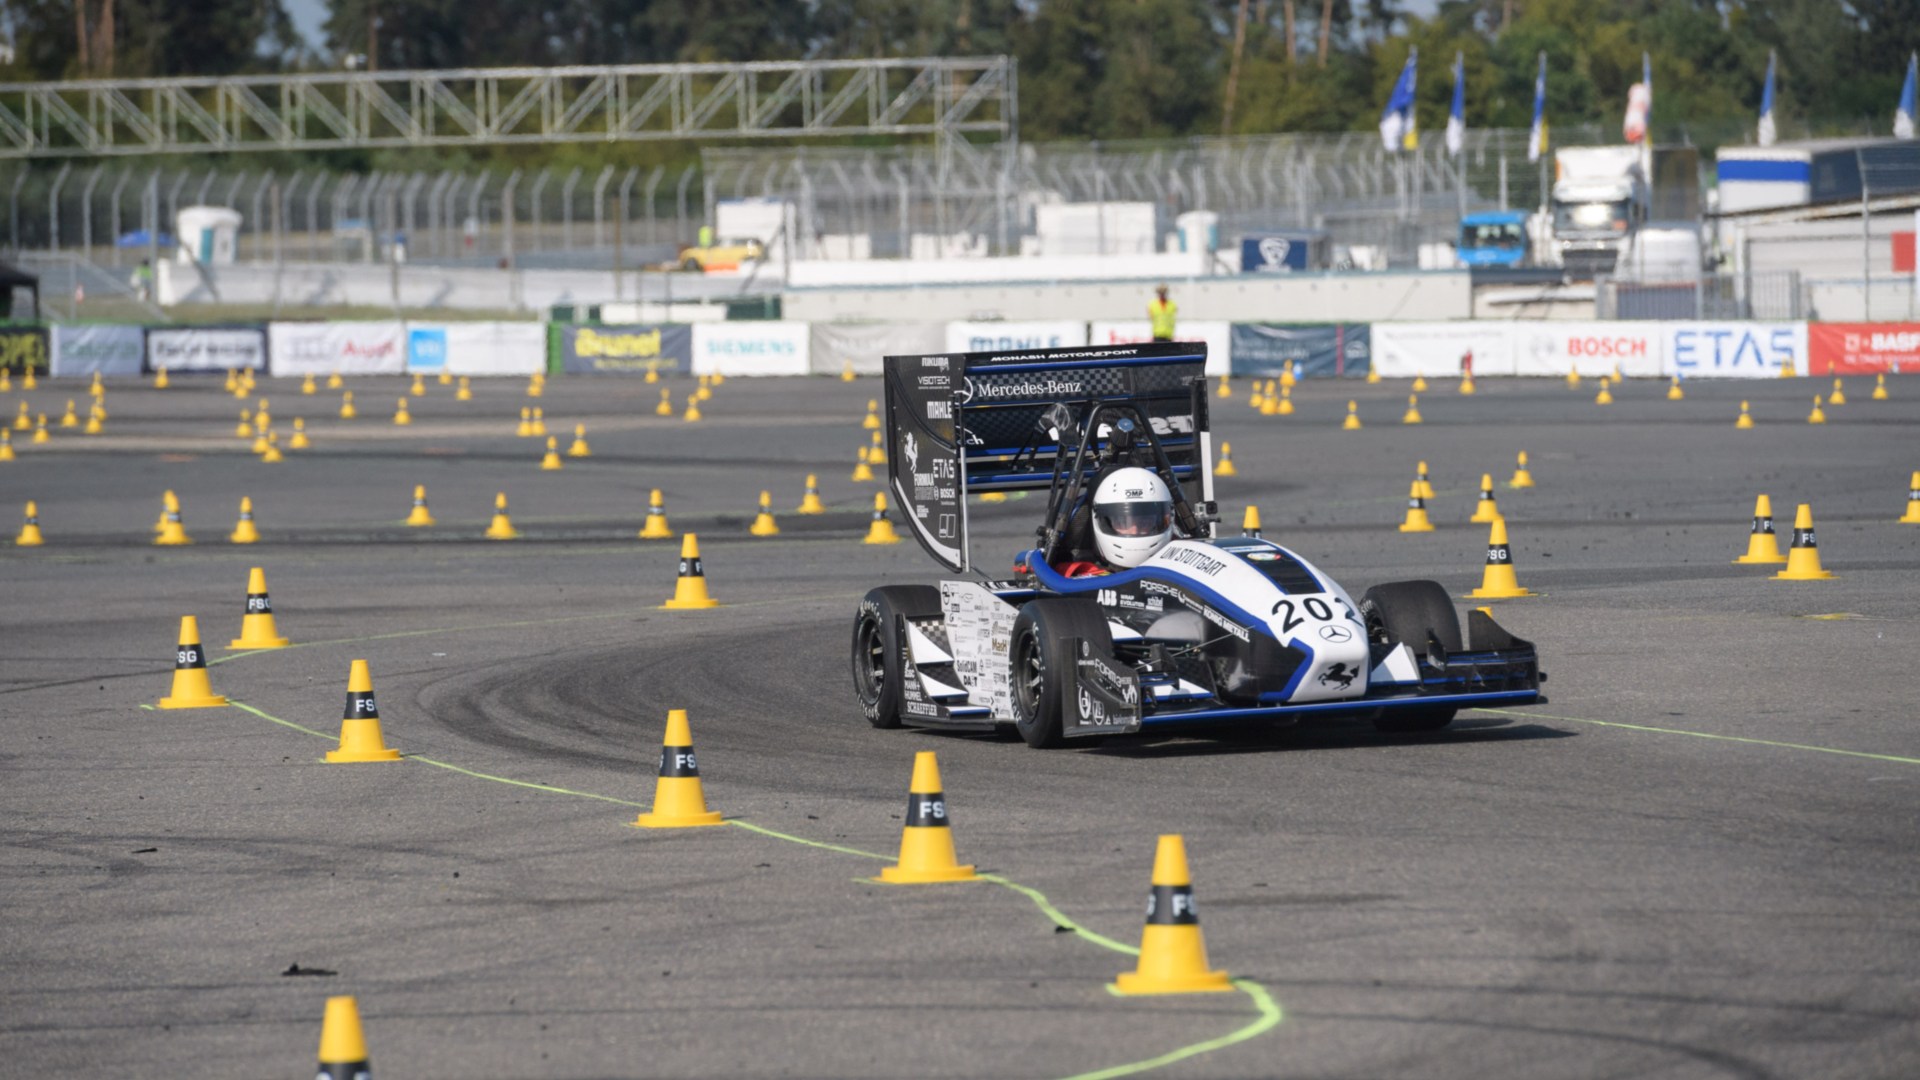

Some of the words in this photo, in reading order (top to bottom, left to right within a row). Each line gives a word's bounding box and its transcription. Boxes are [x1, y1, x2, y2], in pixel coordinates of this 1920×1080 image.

[706, 338, 795, 356] SIEMENS
[1048, 349, 1138, 359] MOTORSPORT
[1567, 337, 1646, 356] BOSCH
[1674, 330, 1794, 367] ETAS
[978, 380, 1082, 397] Mercedes-Benz
[927, 401, 952, 419] MAHLE
[933, 458, 955, 478] ETAS
[914, 472, 935, 487] FORMULA
[940, 488, 956, 498] BOSCH
[1125, 489, 1144, 498] OMP
[1160, 546, 1181, 560] UNI
[1174, 548, 1227, 577] STUTTGART
[1096, 589, 1118, 607] ABB
[1140, 580, 1179, 599] PORSCHE
[907, 701, 938, 716] SCHAEFFLER
